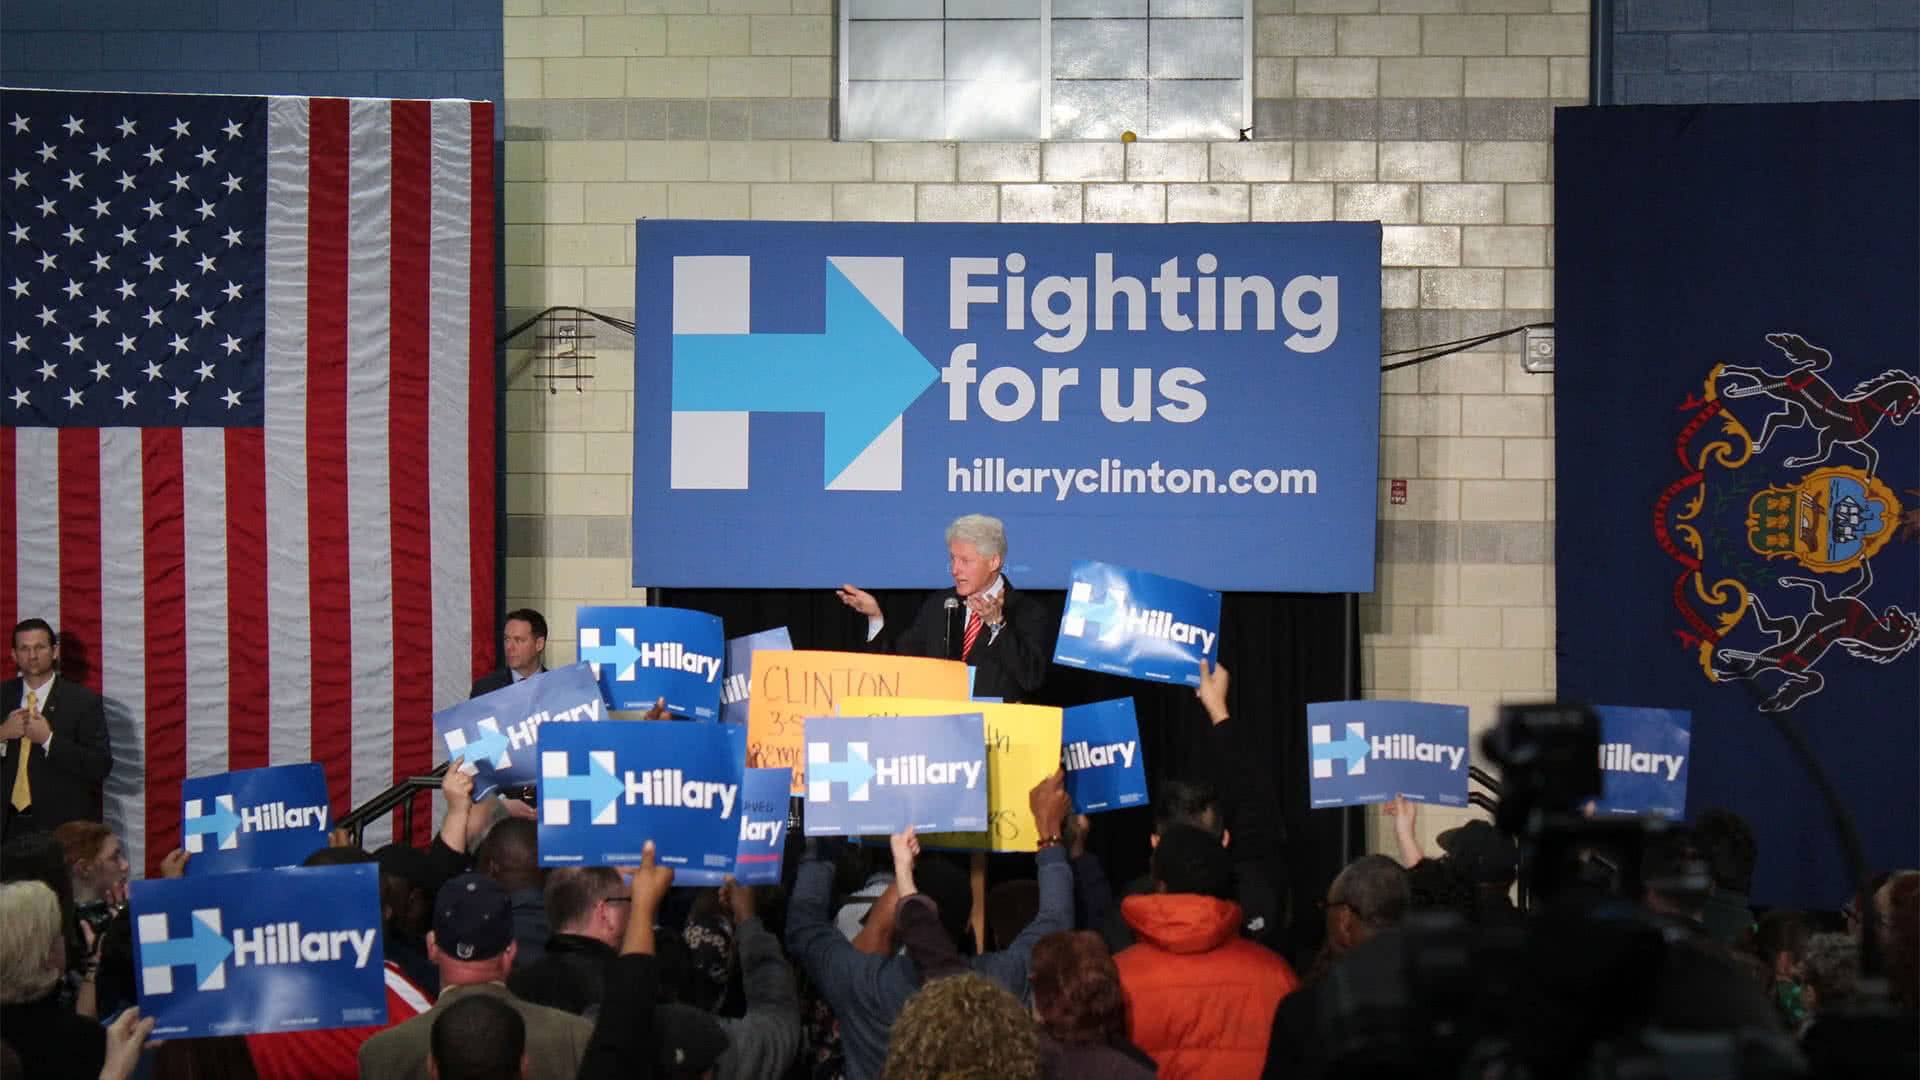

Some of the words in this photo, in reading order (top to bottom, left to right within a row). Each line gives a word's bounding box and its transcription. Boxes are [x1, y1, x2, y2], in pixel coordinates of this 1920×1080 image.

[948, 252, 1340, 353] Fighting
[941, 342, 1079, 422] for
[1099, 366, 1208, 423] us
[948, 457, 1318, 501] hillaryclinton.com
[1129, 608, 1216, 655] Hillary
[641, 642, 722, 683] Hillary
[764, 664, 900, 710] CLINTON
[876, 755, 982, 789] Hillary
[1371, 734, 1465, 771] Hillary
[241, 801, 328, 833] Hillary
[624, 769, 738, 819] Hillary
[233, 921, 377, 968] Hillary
